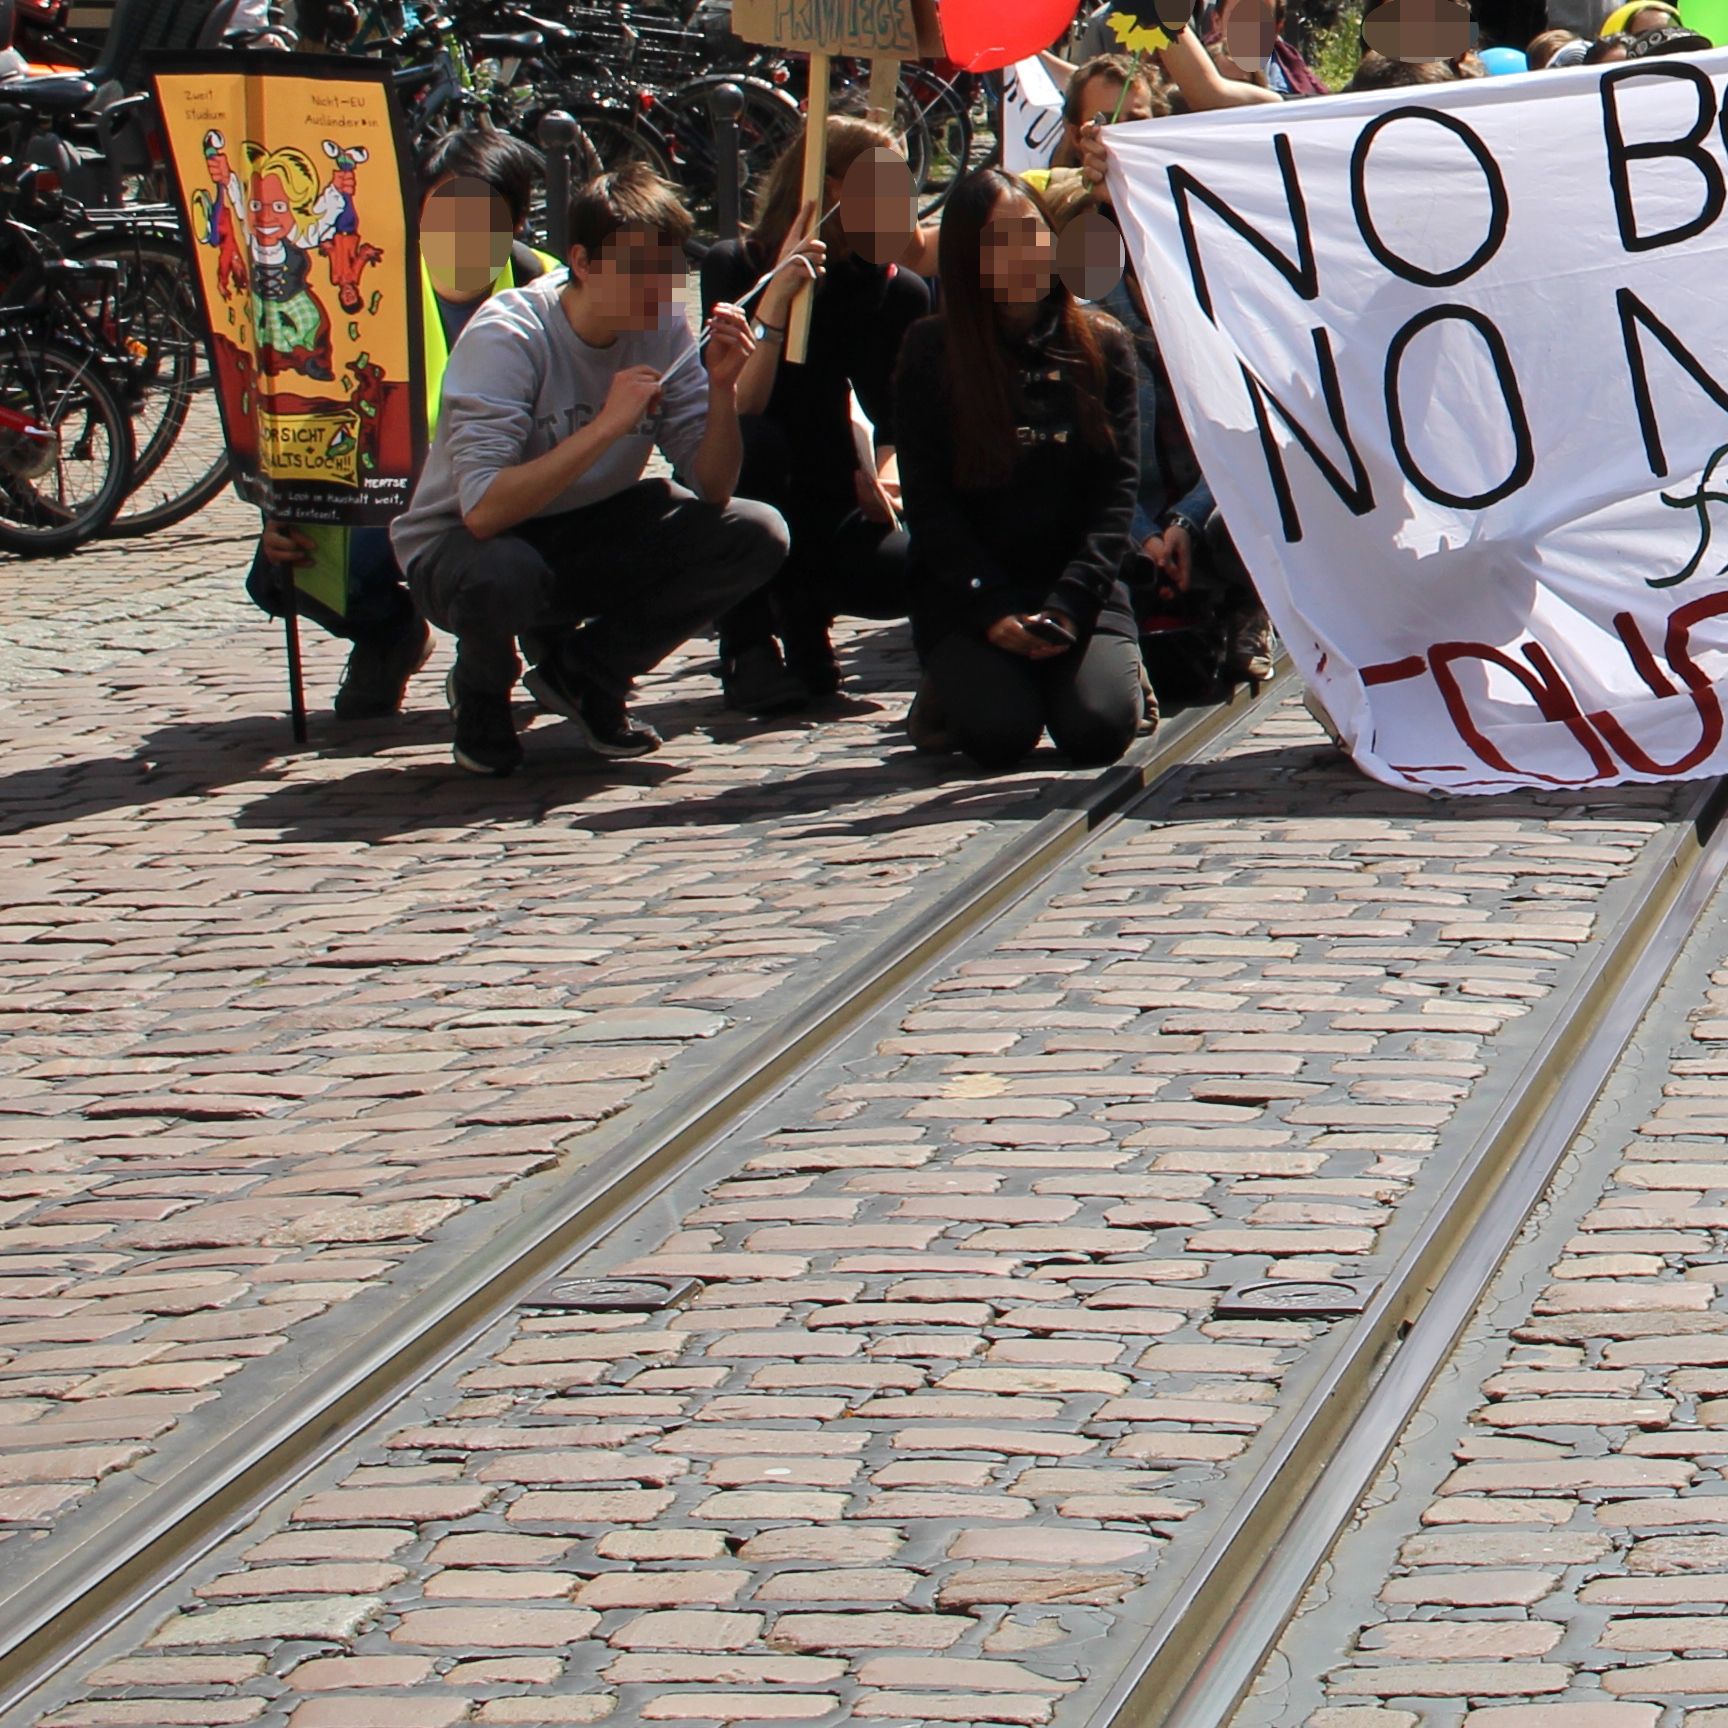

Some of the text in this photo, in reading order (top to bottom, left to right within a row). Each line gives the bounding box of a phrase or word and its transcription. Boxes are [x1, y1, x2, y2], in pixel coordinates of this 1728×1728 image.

[1166, 102, 1510, 327] NO
[263, 426, 326, 444] ORSICHT
[1236, 301, 1535, 544] NO
